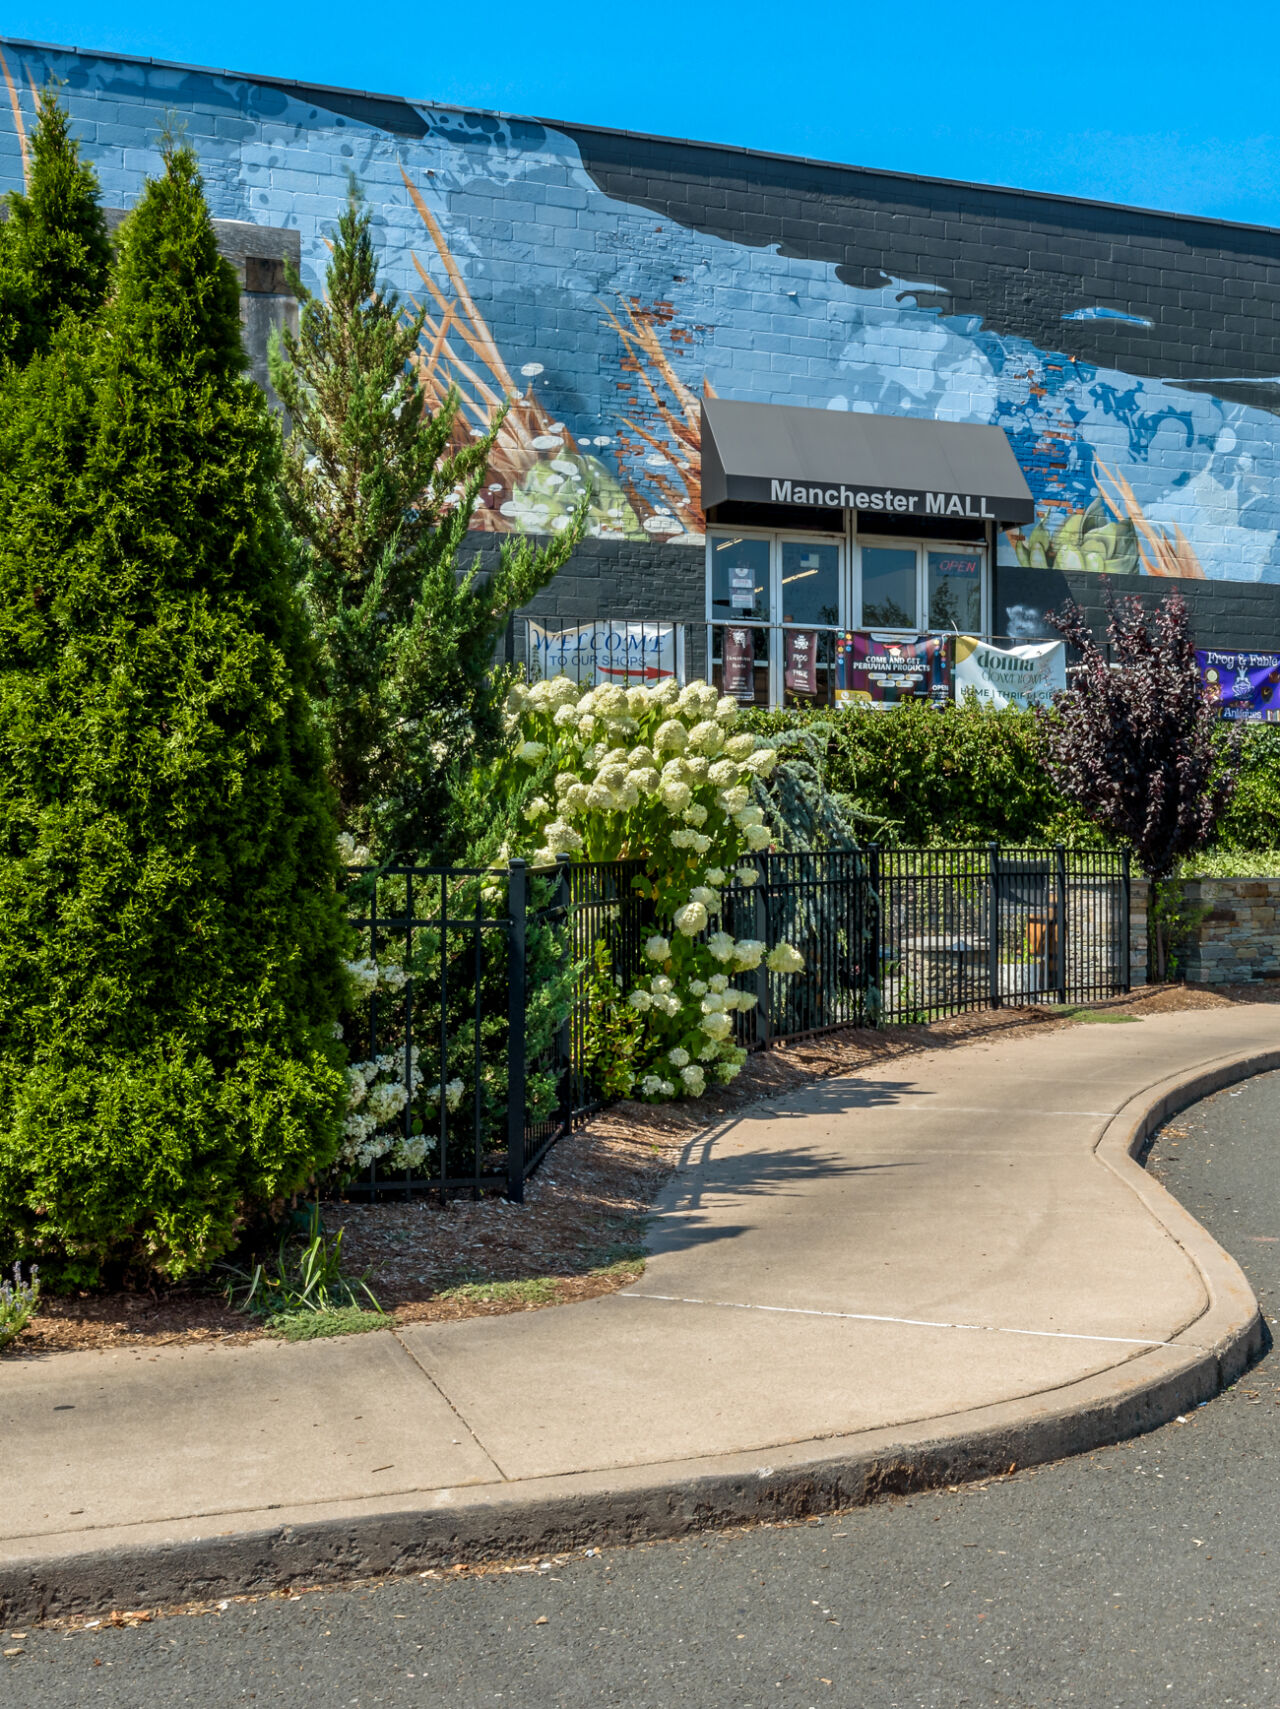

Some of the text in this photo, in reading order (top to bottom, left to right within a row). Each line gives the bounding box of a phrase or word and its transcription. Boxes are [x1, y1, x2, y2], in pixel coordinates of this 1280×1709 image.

[771, 479, 995, 519] Manchester MALL
[939, 560, 976, 573] OPEN
[531, 629, 666, 653] WELCOME
[549, 655, 647, 667] TO OUR SHOPS
[853, 661, 931, 672] PERUVIAN PRODUCTS
[889, 656, 905, 664] AND
[906, 657, 921, 665] GET
[977, 650, 1034, 672] donna
[1207, 652, 1278, 670] Frog & Fable
[1224, 707, 1262, 719] Antiques
